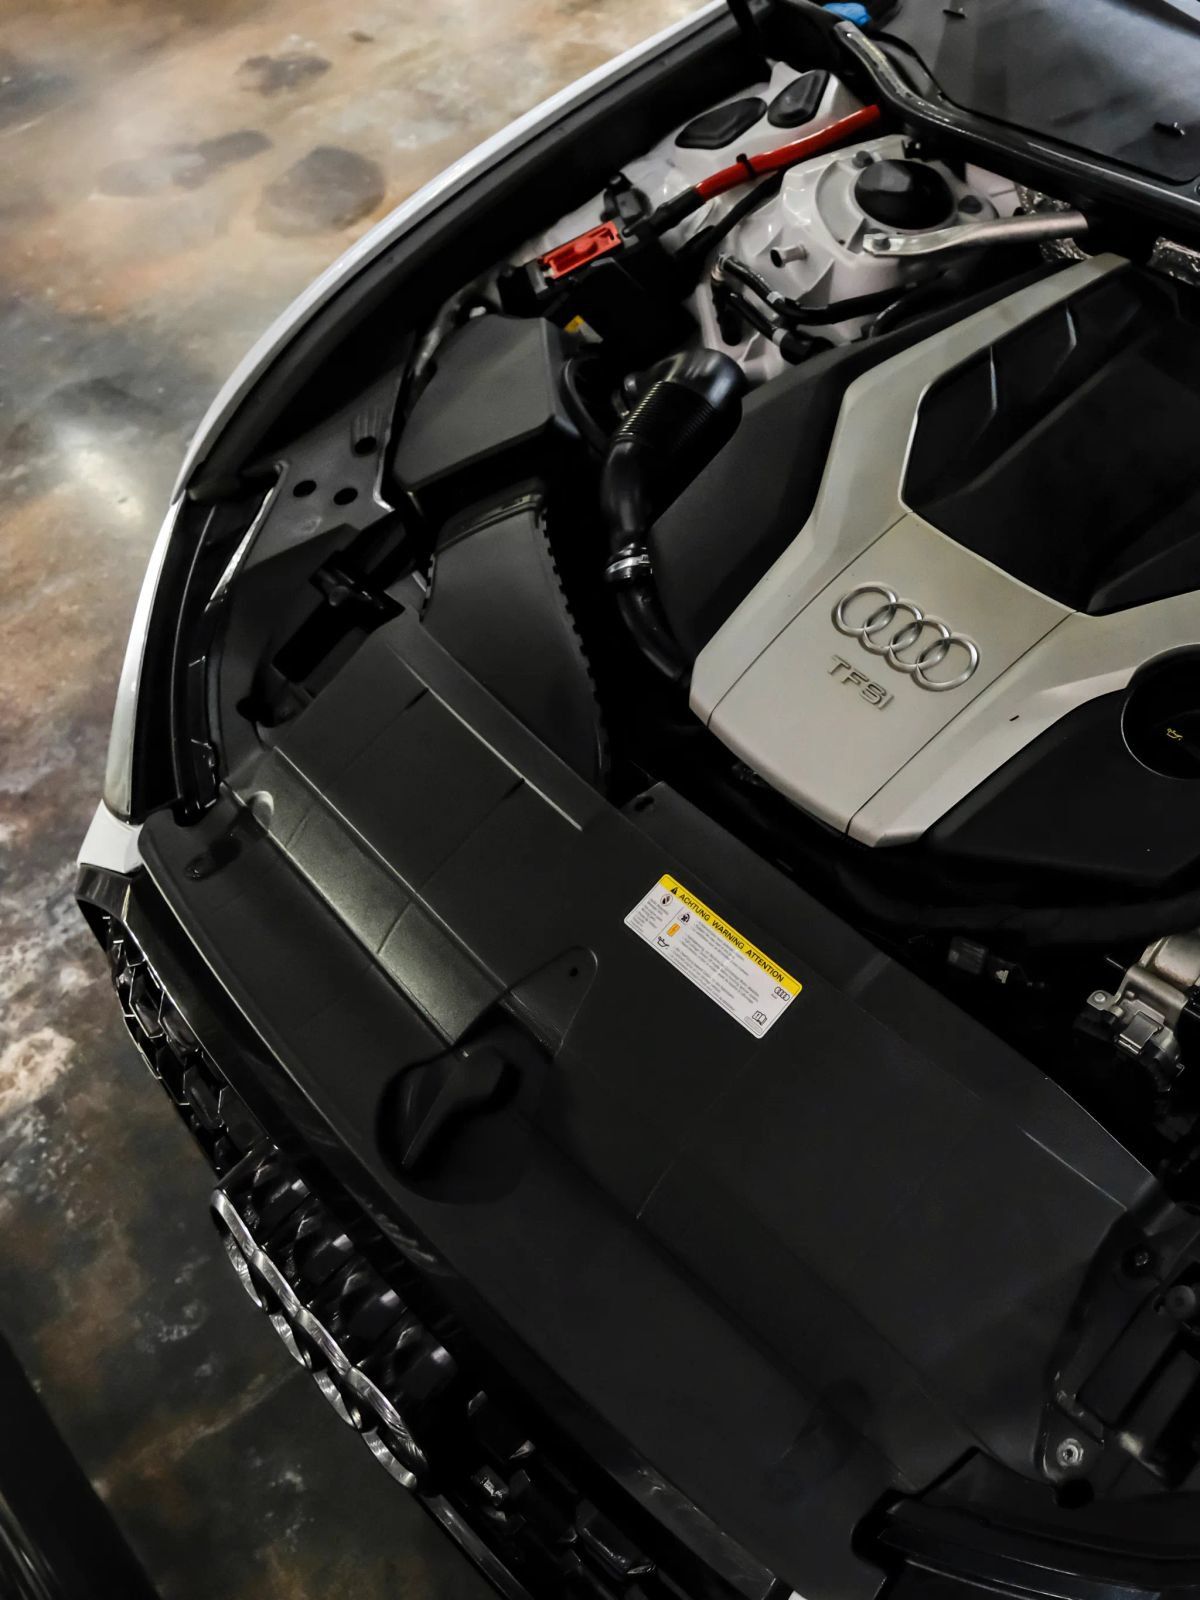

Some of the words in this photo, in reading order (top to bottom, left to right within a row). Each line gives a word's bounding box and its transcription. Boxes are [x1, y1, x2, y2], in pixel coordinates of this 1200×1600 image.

[827, 654, 895, 711] TFSI
[679, 894, 711, 921] ACHTUNG
[711, 920, 745, 950] WARNING
[745, 949, 785, 982] ATTENTION
